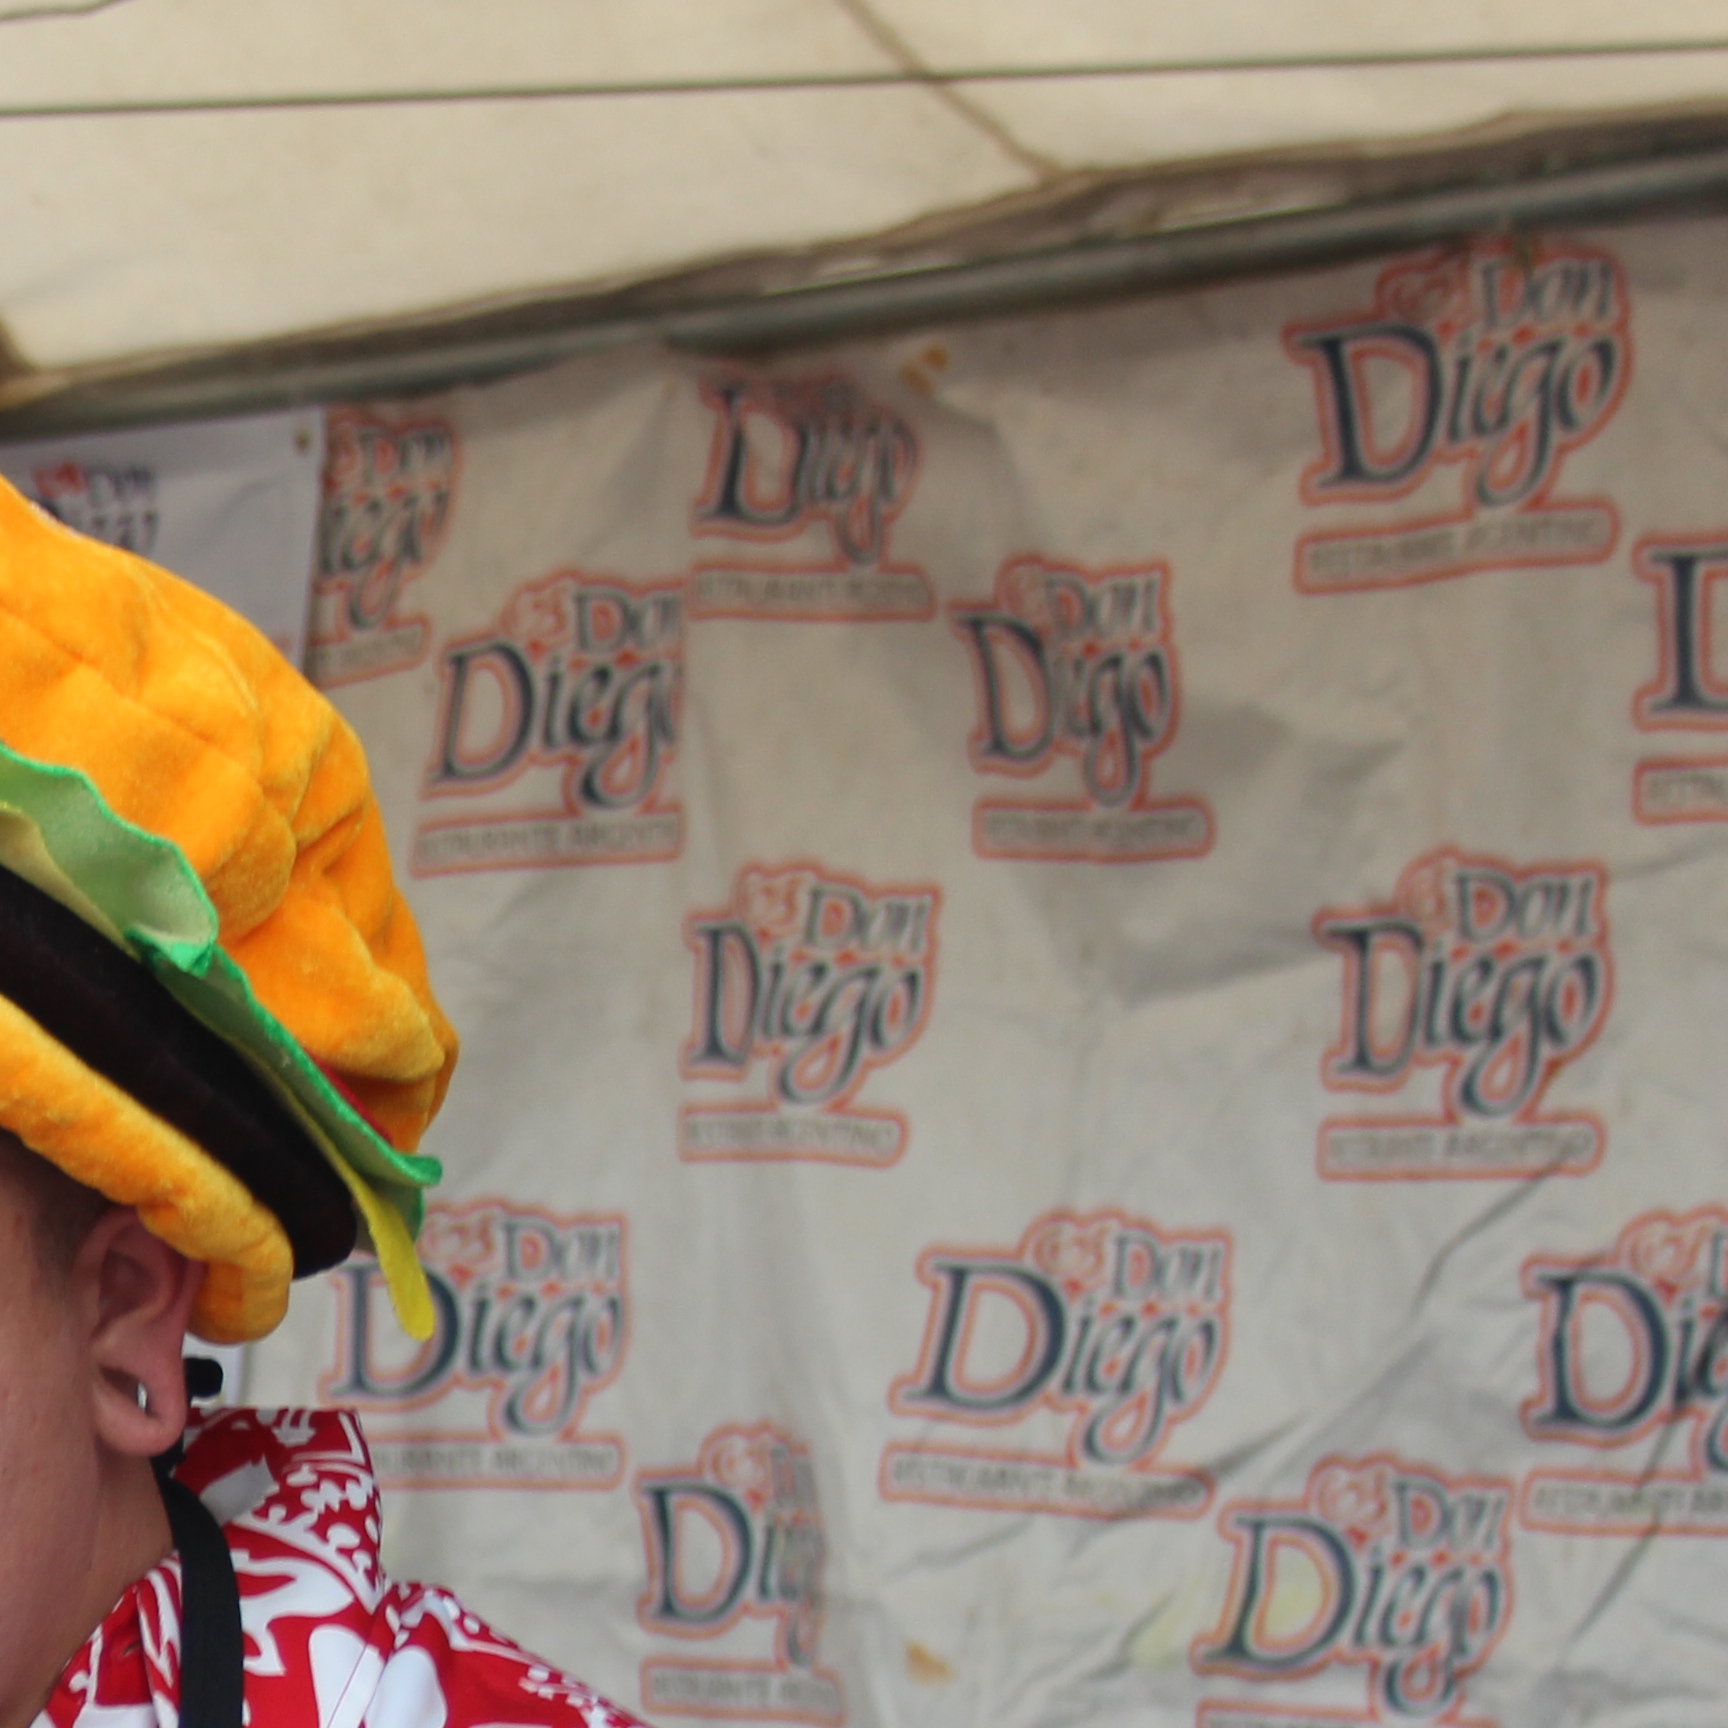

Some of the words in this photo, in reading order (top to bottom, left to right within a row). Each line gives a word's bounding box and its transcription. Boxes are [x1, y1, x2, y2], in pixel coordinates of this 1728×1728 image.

[1297, 322, 1617, 506] Diego
[808, 886, 930, 951] Don
[1455, 869, 1593, 939] Don
[691, 918, 923, 1104] Diego
[1328, 918, 1598, 1120] Diego
[503, 1218, 621, 1283] Don
[1114, 1229, 1225, 1300] Don
[330, 1257, 624, 1436] Diego
[904, 1258, 1217, 1466] Diego
[1394, 1480, 1506, 1550] Don
[1204, 1514, 1502, 1719] Diego
